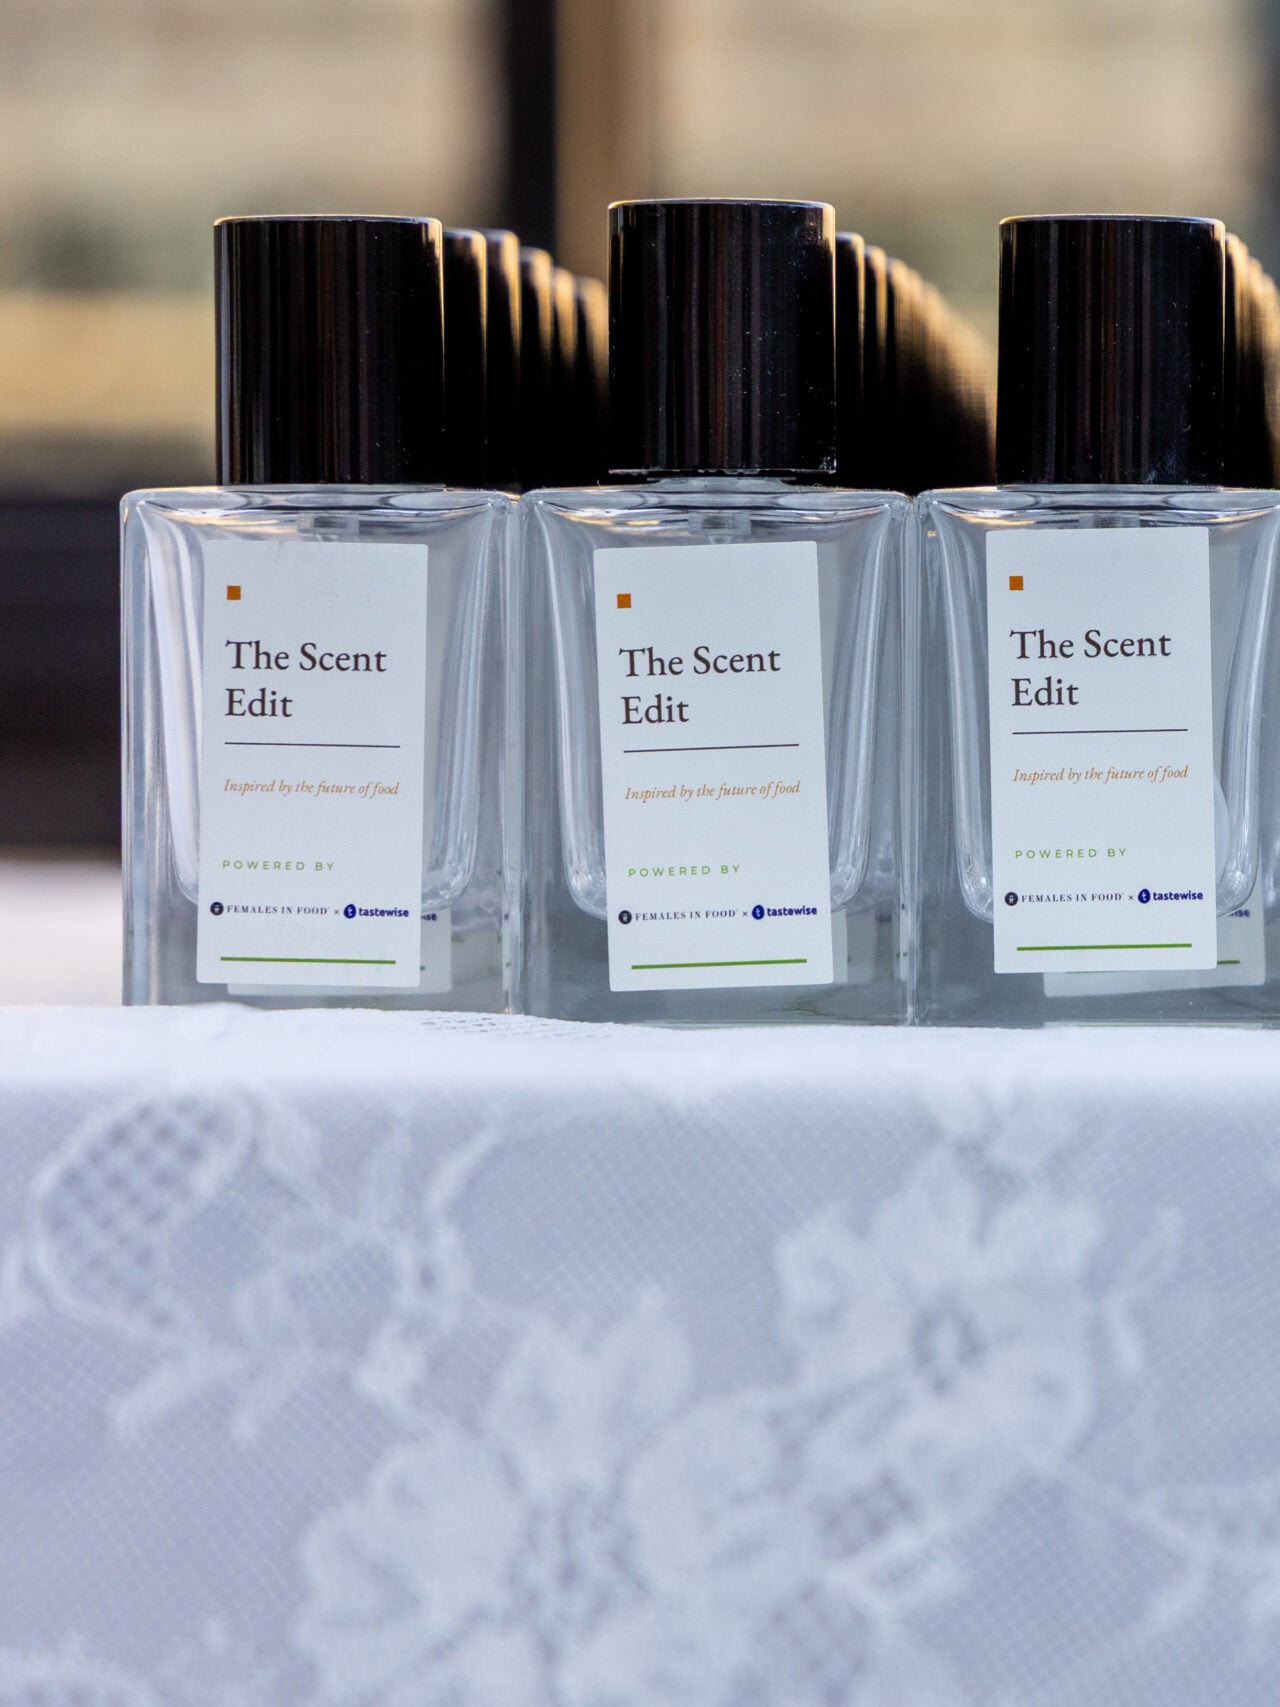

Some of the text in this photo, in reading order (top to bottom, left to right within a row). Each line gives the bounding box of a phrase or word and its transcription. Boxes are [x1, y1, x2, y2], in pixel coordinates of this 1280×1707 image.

[1009, 629, 1171, 659] The Scent
[224, 639, 387, 673] The Scent
[618, 646, 781, 677] The Scent
[1011, 676, 1079, 707] Edit
[224, 687, 293, 718] Edit
[620, 694, 689, 725] Edit
[1012, 765, 1189, 786] Inspired by the future of food
[224, 779, 400, 799] Inspired by the future of food
[624, 780, 801, 804] Inspired by the future of food
[1015, 847, 1127, 859] POWERED BY
[222, 859, 334, 872] POWERED BY
[627, 864, 740, 878] POWERED BY
[1021, 894, 1072, 903] FEMALES
[1075, 893, 1087, 902] IN
[1152, 889, 1203, 901] tastewise
[226, 905, 278, 914] FEMALES
[281, 906, 292, 915] IN
[358, 907, 410, 917] tastewise
[635, 911, 687, 922] FEMALES
[690, 910, 701, 920] IN
[766, 904, 818, 917] tastewise
